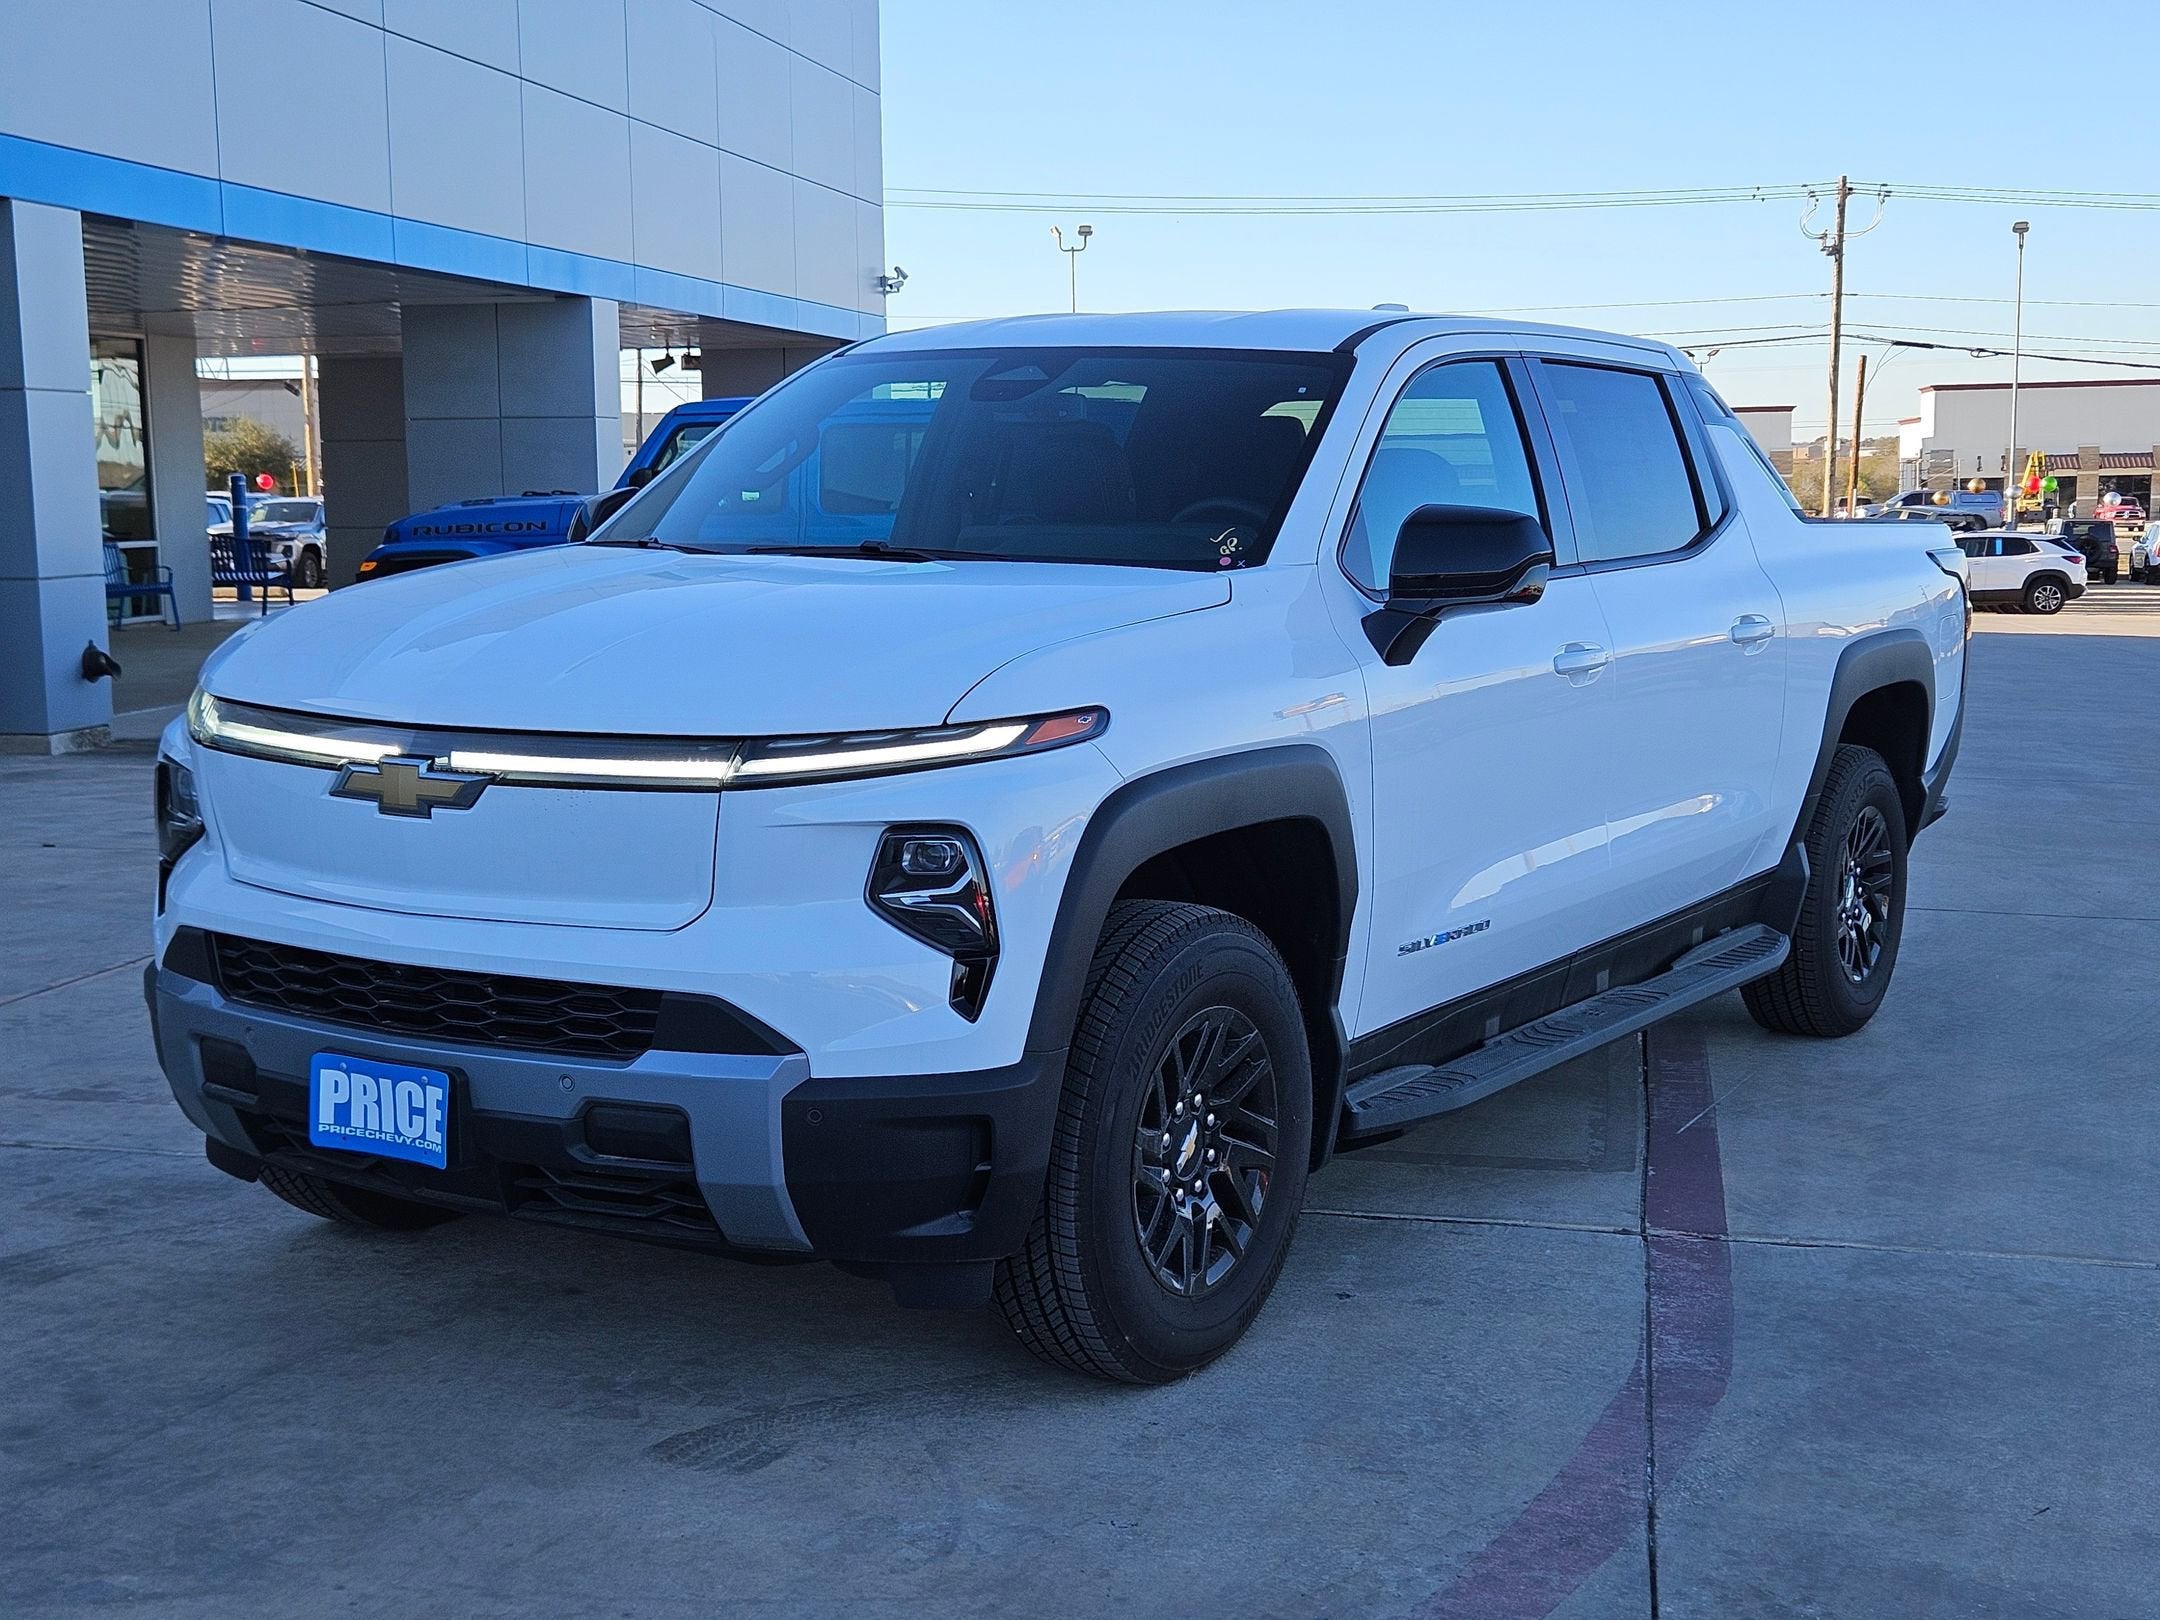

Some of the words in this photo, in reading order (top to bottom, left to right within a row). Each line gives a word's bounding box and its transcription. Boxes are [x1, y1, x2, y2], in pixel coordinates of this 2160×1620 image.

[412, 520, 548, 537] RUBICON
[318, 1068, 444, 1145] PRICE
[317, 1123, 443, 1154] PRICECHEVY.COM
